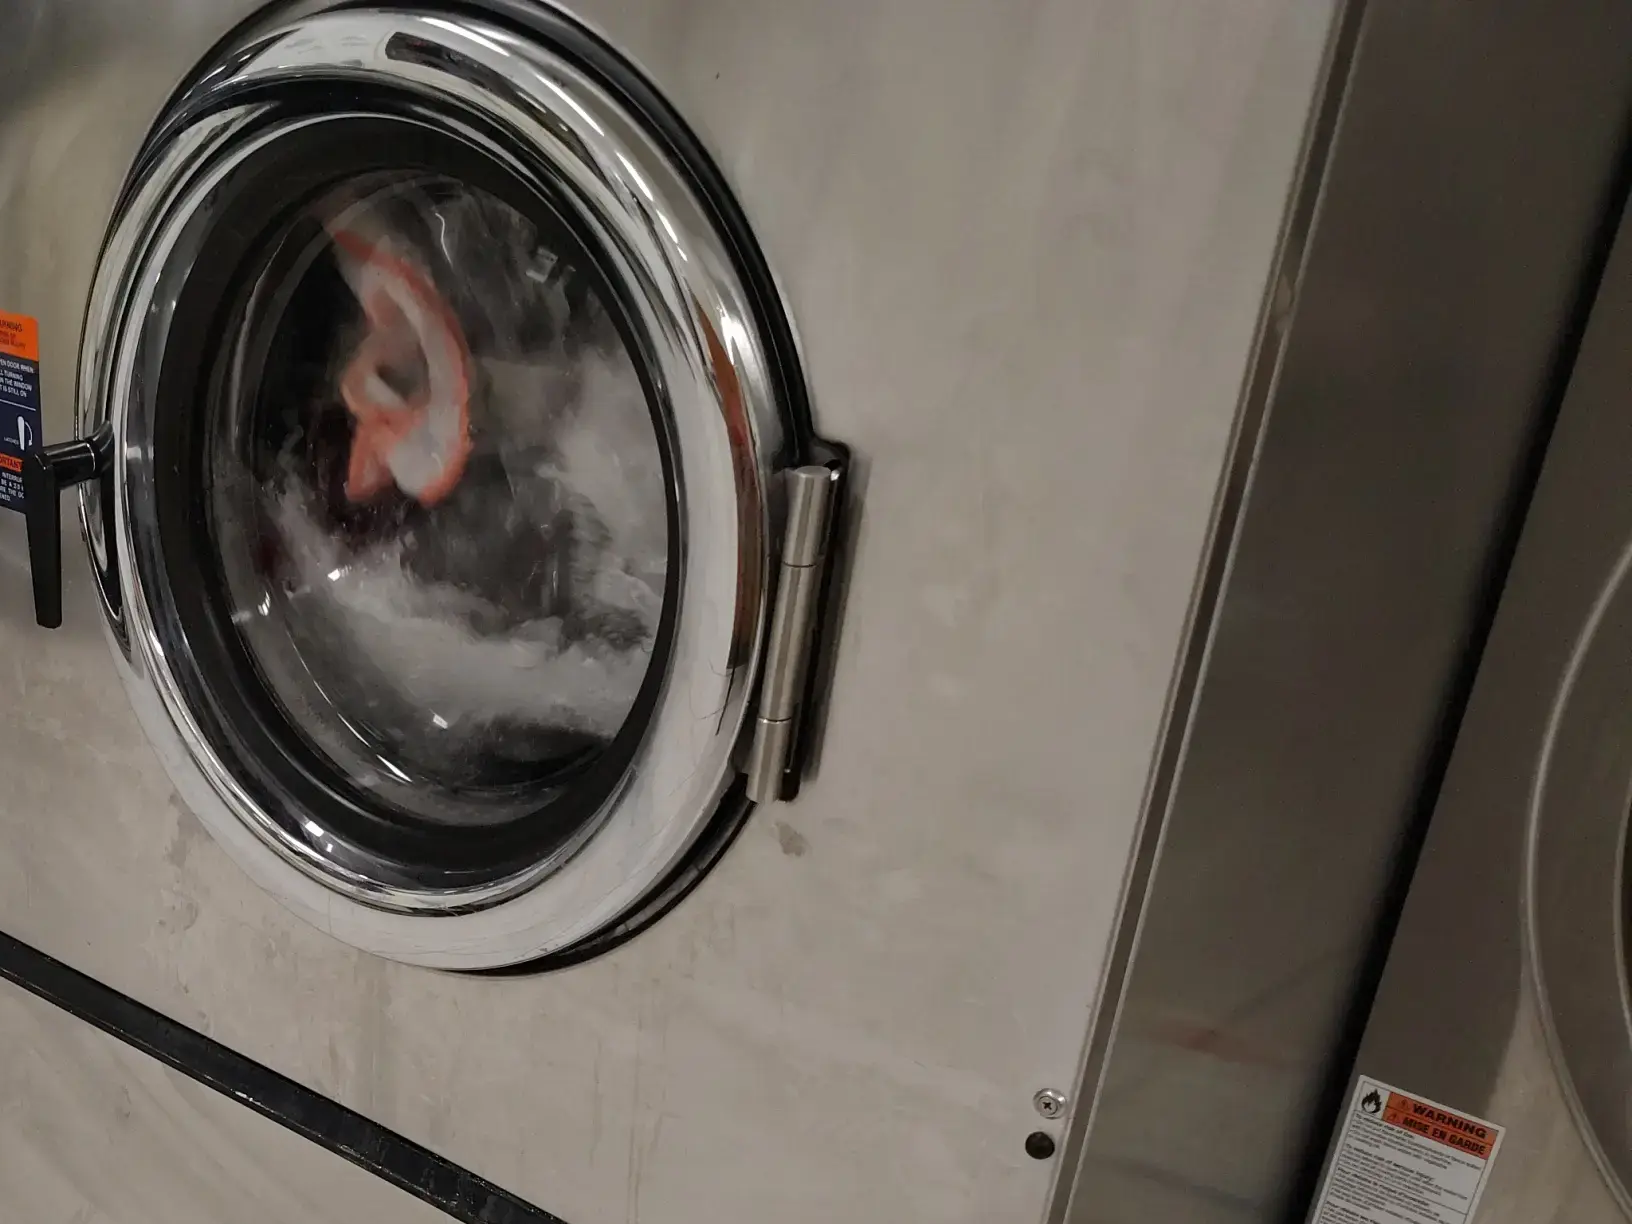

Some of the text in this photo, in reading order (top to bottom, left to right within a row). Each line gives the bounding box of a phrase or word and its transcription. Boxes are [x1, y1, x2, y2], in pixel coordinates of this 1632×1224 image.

[7, 361, 19, 369] DOOR
[4, 370, 23, 381] TURNING
[4, 378, 13, 386] THE
[7, 387, 19, 396] STILL
[1411, 1103, 1487, 1139] WARNING
[1402, 1116, 1430, 1134] MISE
[1431, 1128, 1447, 1140] EN
[1448, 1134, 1486, 1155] GARDE
